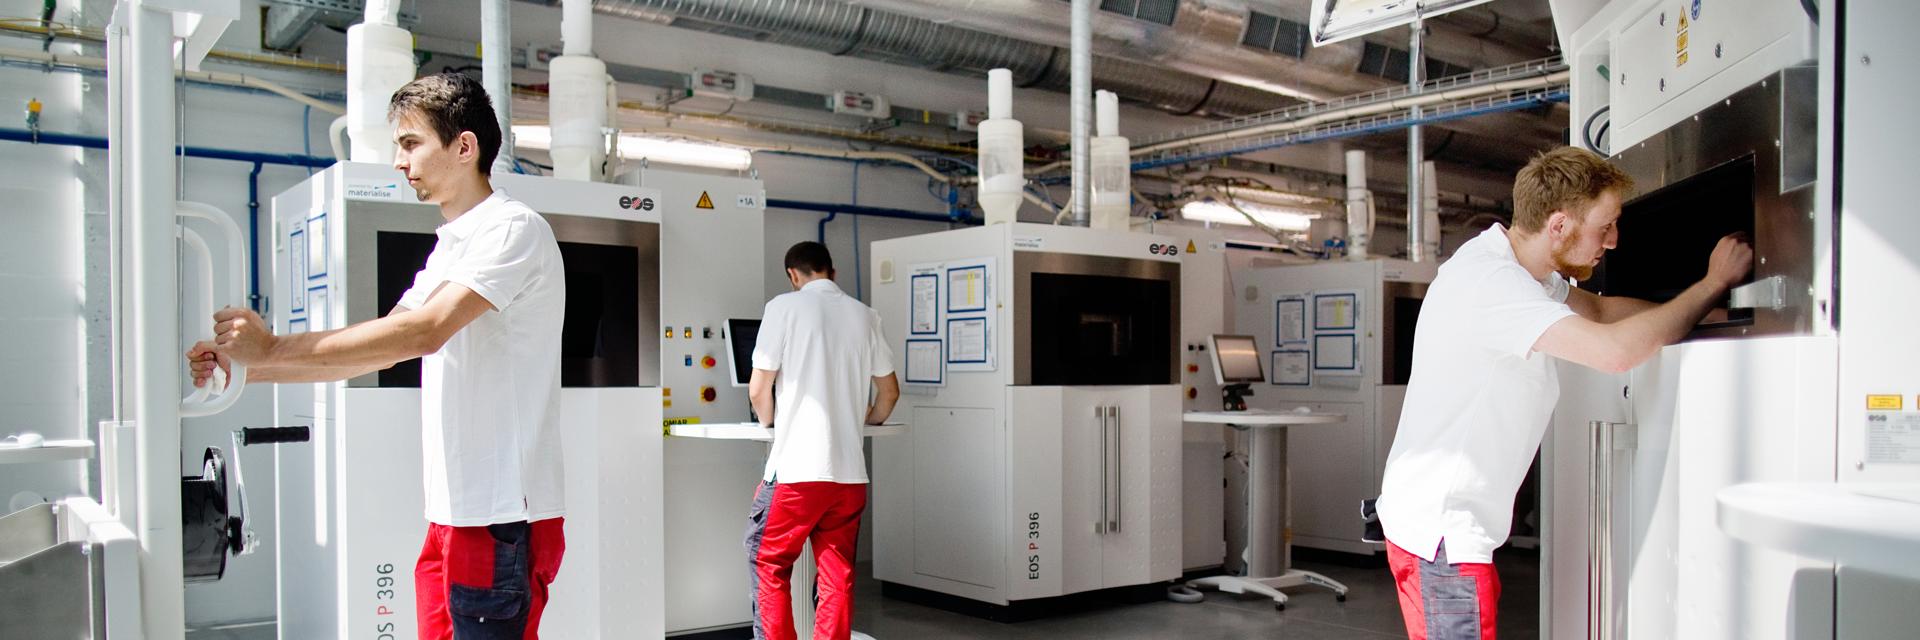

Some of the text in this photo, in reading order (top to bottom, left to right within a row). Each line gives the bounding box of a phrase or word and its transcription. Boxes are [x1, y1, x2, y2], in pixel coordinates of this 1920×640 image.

[619, 196, 654, 210] eos
[1149, 243, 1178, 256] eos
[1029, 512, 1039, 580] EOS P 396
[376, 563, 394, 600] 396
[377, 605, 394, 615] P
